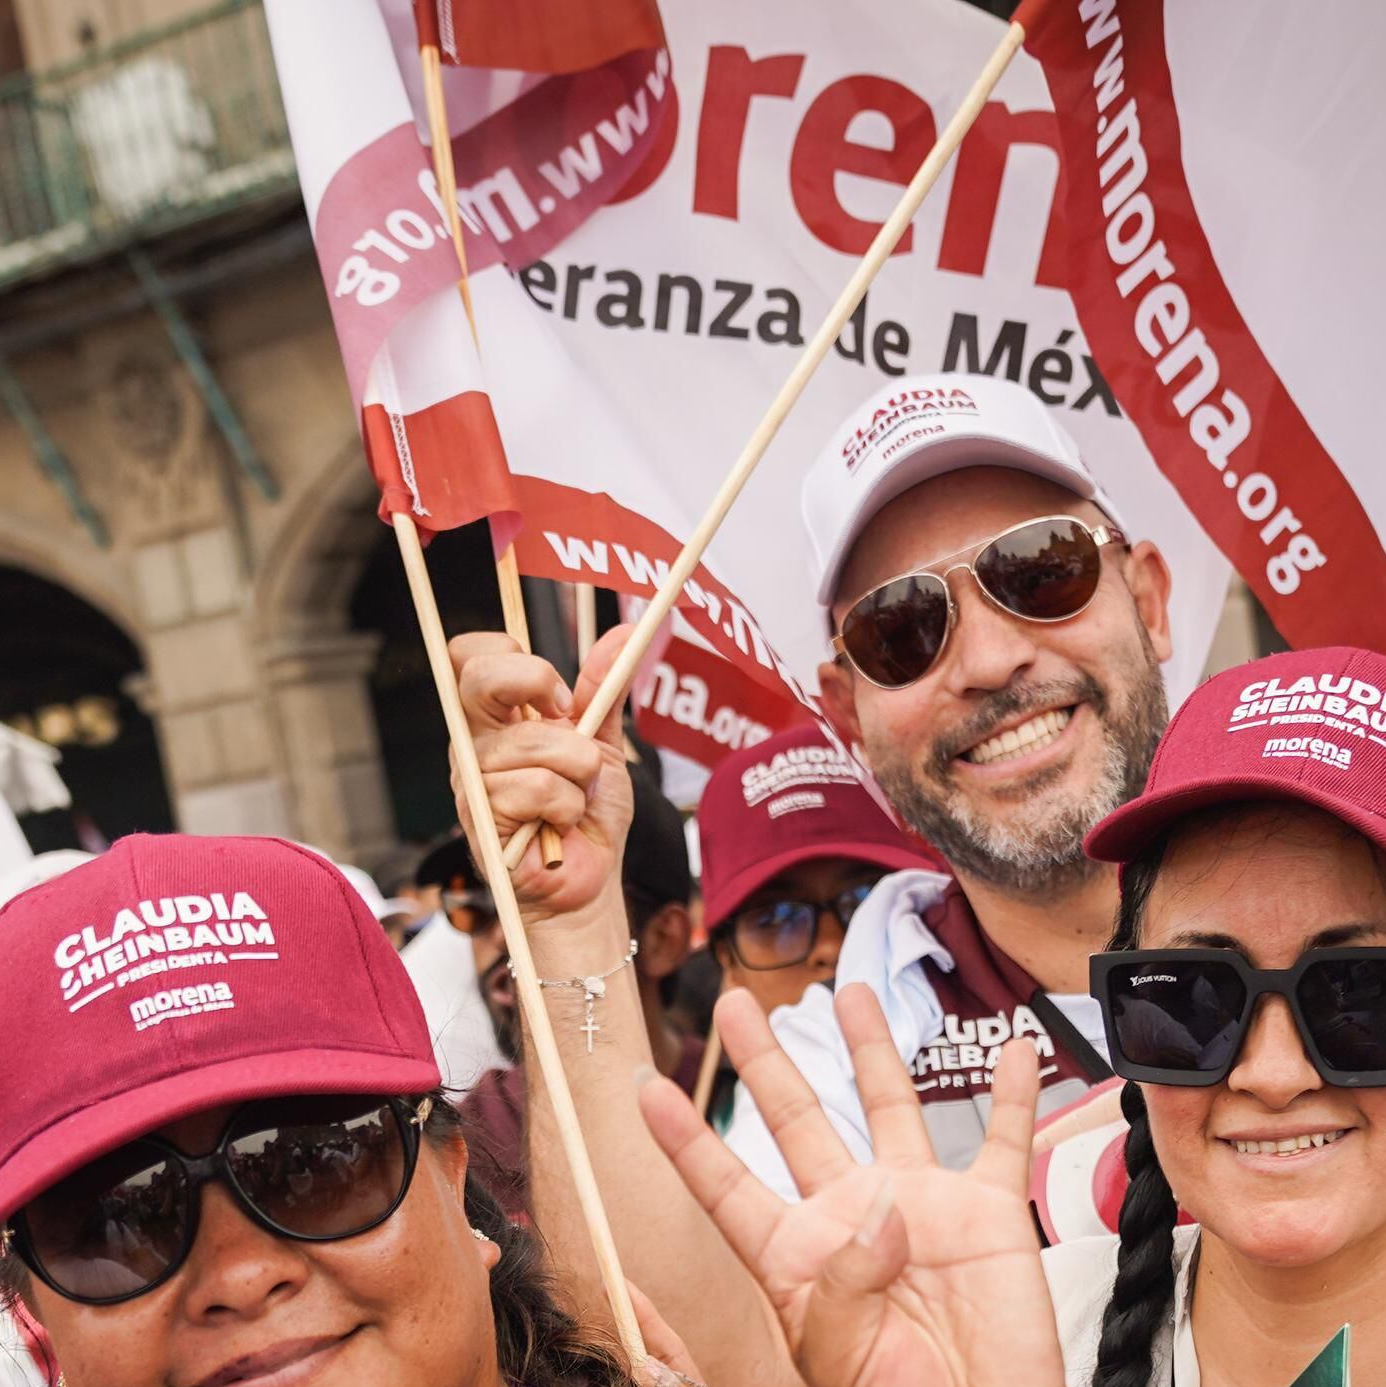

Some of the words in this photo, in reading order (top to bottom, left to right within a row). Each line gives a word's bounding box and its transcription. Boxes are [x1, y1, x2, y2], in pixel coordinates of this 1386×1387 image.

[841, 387, 976, 458] CLAUDIA
[845, 400, 979, 471] SHEINBAUM
[881, 423, 947, 460] morena
[1269, 713, 1366, 739] PRESIDENTA
[1264, 737, 1352, 764] morena
[54, 891, 269, 970] CLAUDIA
[60, 921, 277, 1002] SHEINBAUM
[116, 950, 229, 989] PRESIDENTA
[129, 981, 234, 1023] morena
